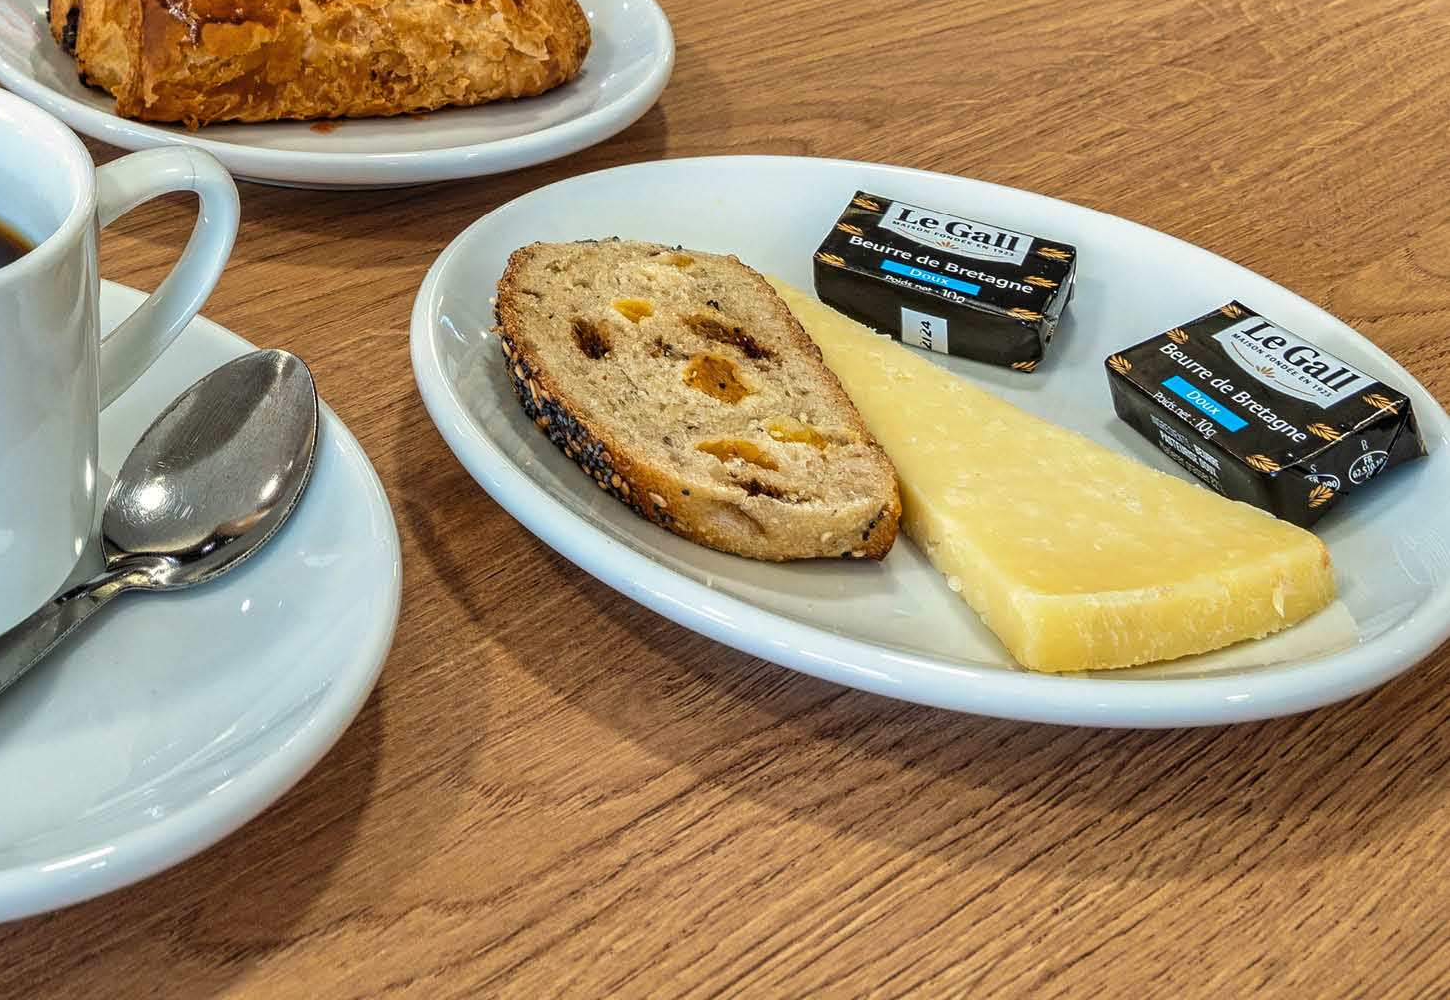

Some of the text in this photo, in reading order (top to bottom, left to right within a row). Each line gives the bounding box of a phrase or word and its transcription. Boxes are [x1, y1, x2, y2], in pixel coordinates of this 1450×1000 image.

[892, 220, 930, 233] MAISON
[993, 248, 1015, 257] 1923
[894, 207, 1020, 251] Le Gall
[849, 235, 1034, 294] Beurre de Bretagne
[910, 268, 949, 286] Doux
[1231, 333, 1333, 398] MAISON FONDÉE EN 1923
[1241, 321, 1361, 393] Le Gall
[1153, 391, 1177, 411] Poids
[1194, 418, 1218, 440] 10g
[1159, 342, 1308, 443] Beurre de Bretagne
[1185, 390, 1222, 415] Doux
[1363, 455, 1373, 465] FR
